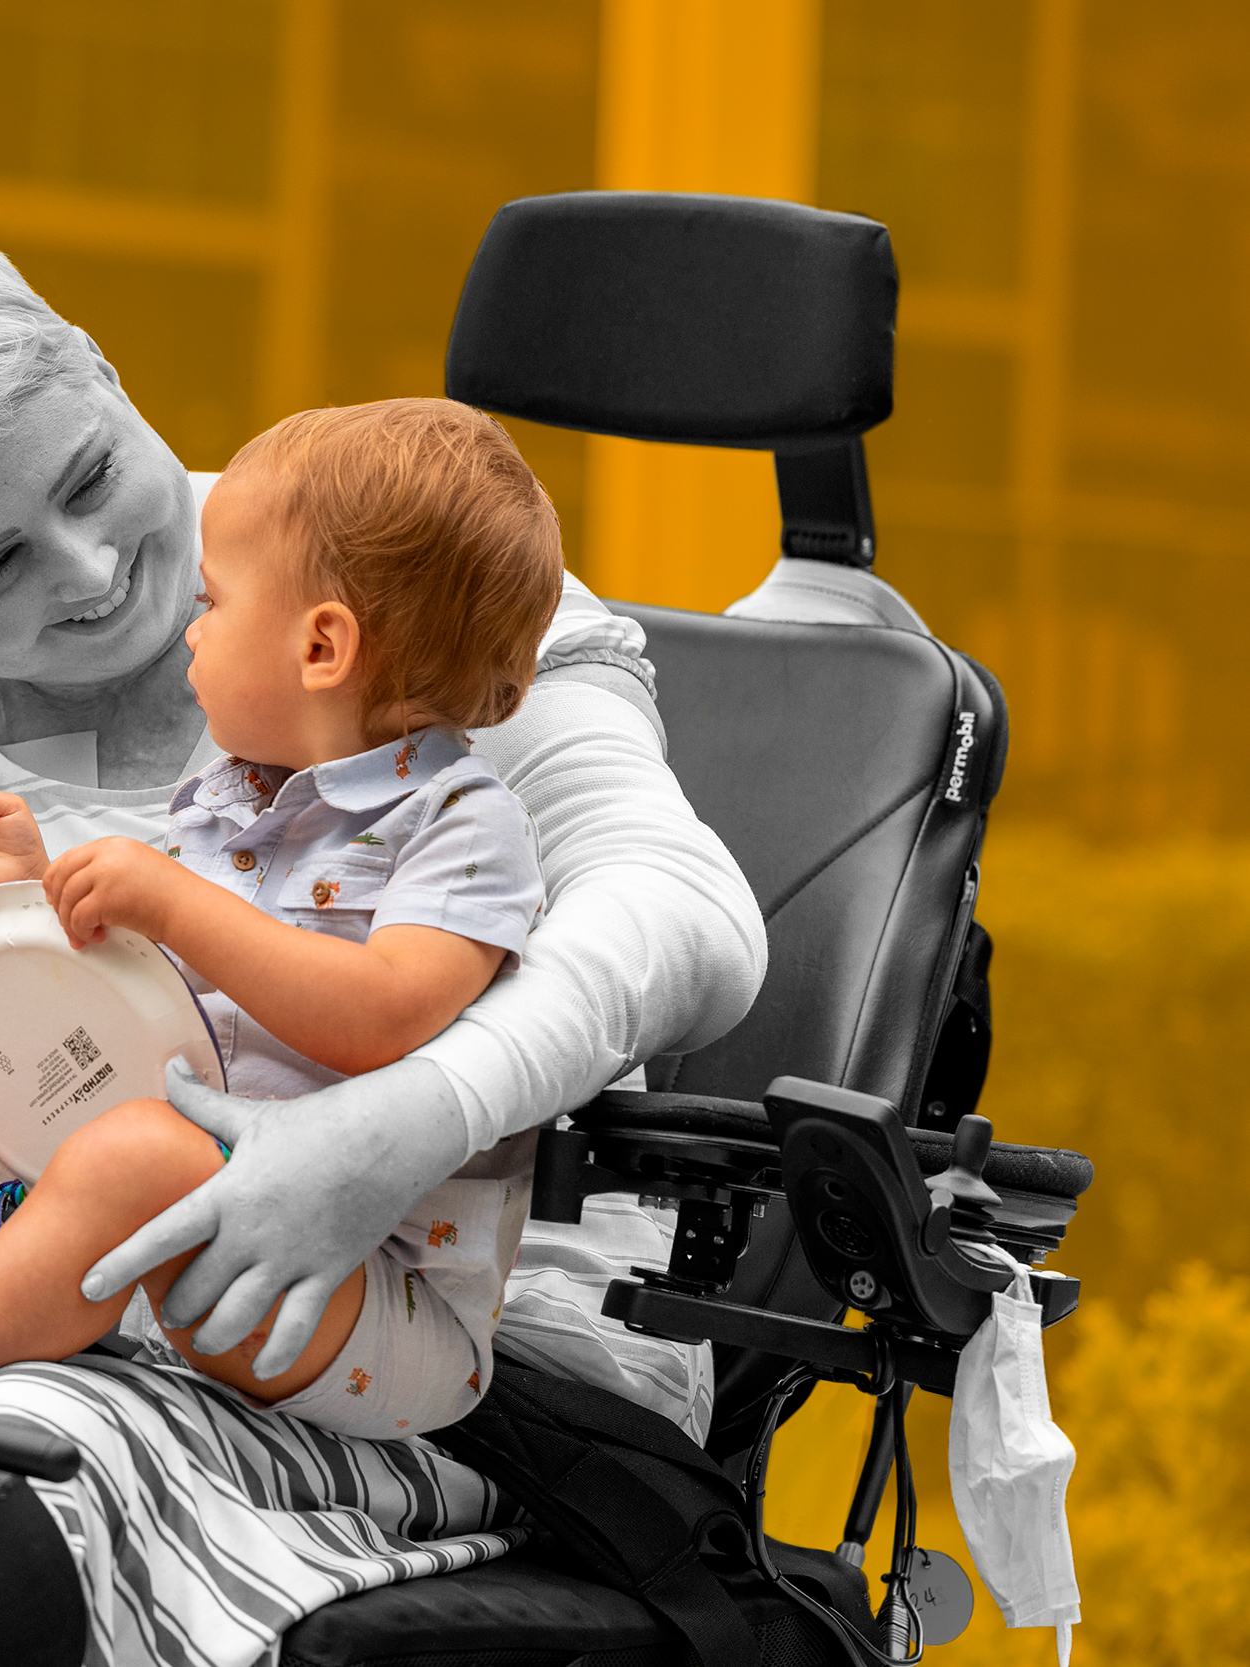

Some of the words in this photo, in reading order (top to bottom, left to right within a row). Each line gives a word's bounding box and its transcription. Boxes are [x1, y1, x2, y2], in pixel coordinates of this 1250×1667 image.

[944, 711, 976, 803] permobil
[71, 1063, 113, 1104] BIRTHDAY
[42, 1096, 73, 1126] EXPRESS
